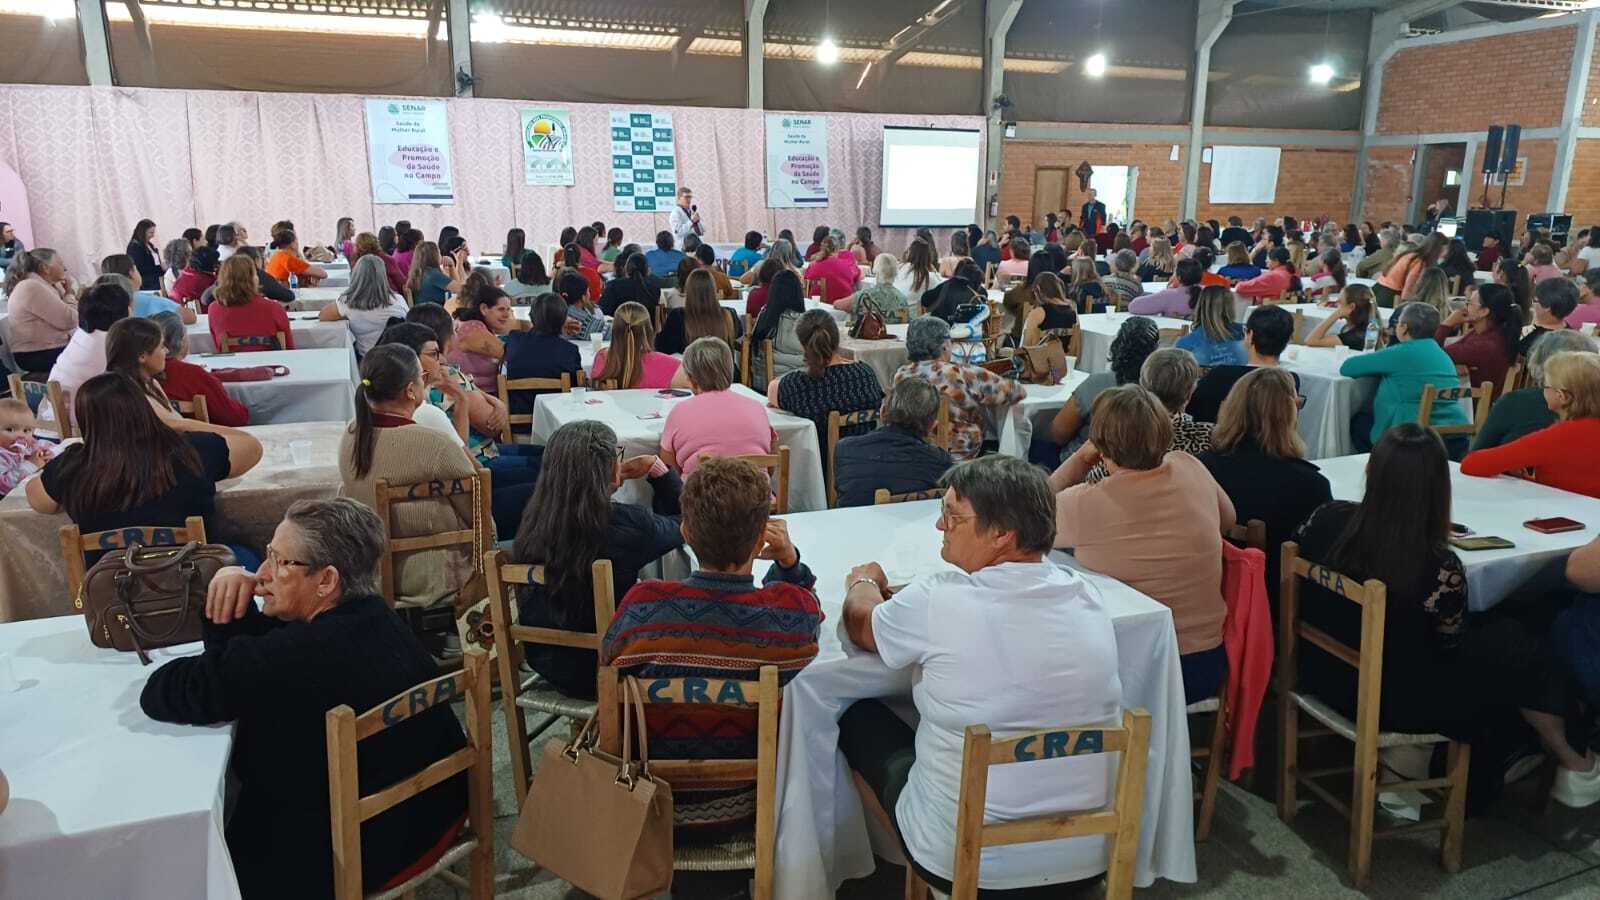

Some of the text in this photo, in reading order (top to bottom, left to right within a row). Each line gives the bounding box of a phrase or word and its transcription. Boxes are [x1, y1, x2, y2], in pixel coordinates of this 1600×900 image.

[397, 144, 433, 153] Educação
[402, 154, 439, 162] Promoção
[787, 154, 814, 162] Educação
[415, 172, 440, 180] Campo
[1438, 387, 1472, 400] CRA
[408, 479, 464, 501] CRA
[100, 527, 176, 549] CRA
[1307, 564, 1345, 596] CRA
[383, 678, 456, 726] CRA
[647, 678, 746, 705] CRA
[1015, 730, 1104, 762] CRA
